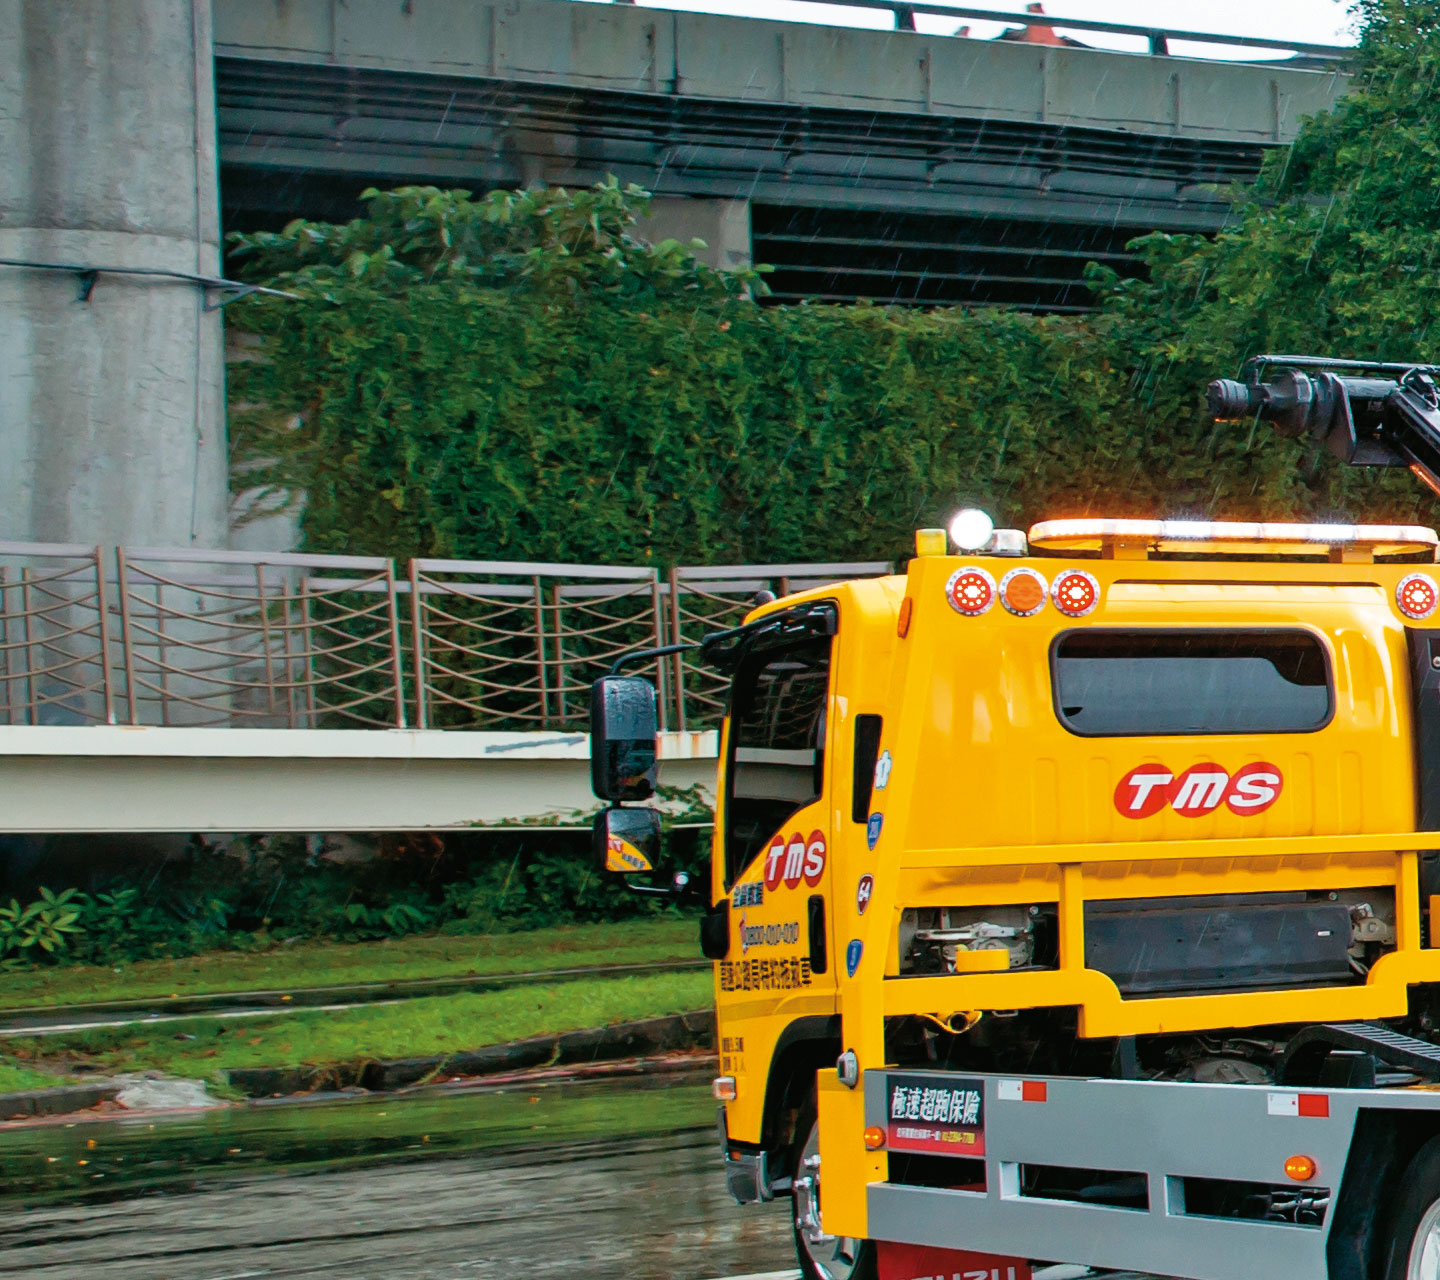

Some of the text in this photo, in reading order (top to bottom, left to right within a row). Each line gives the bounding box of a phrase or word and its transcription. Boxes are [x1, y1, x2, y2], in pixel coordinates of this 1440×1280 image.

[1123, 767, 1281, 814] TMS
[765, 834, 826, 888] TMS
[891, 1085, 982, 1125] 極速超跑保險
